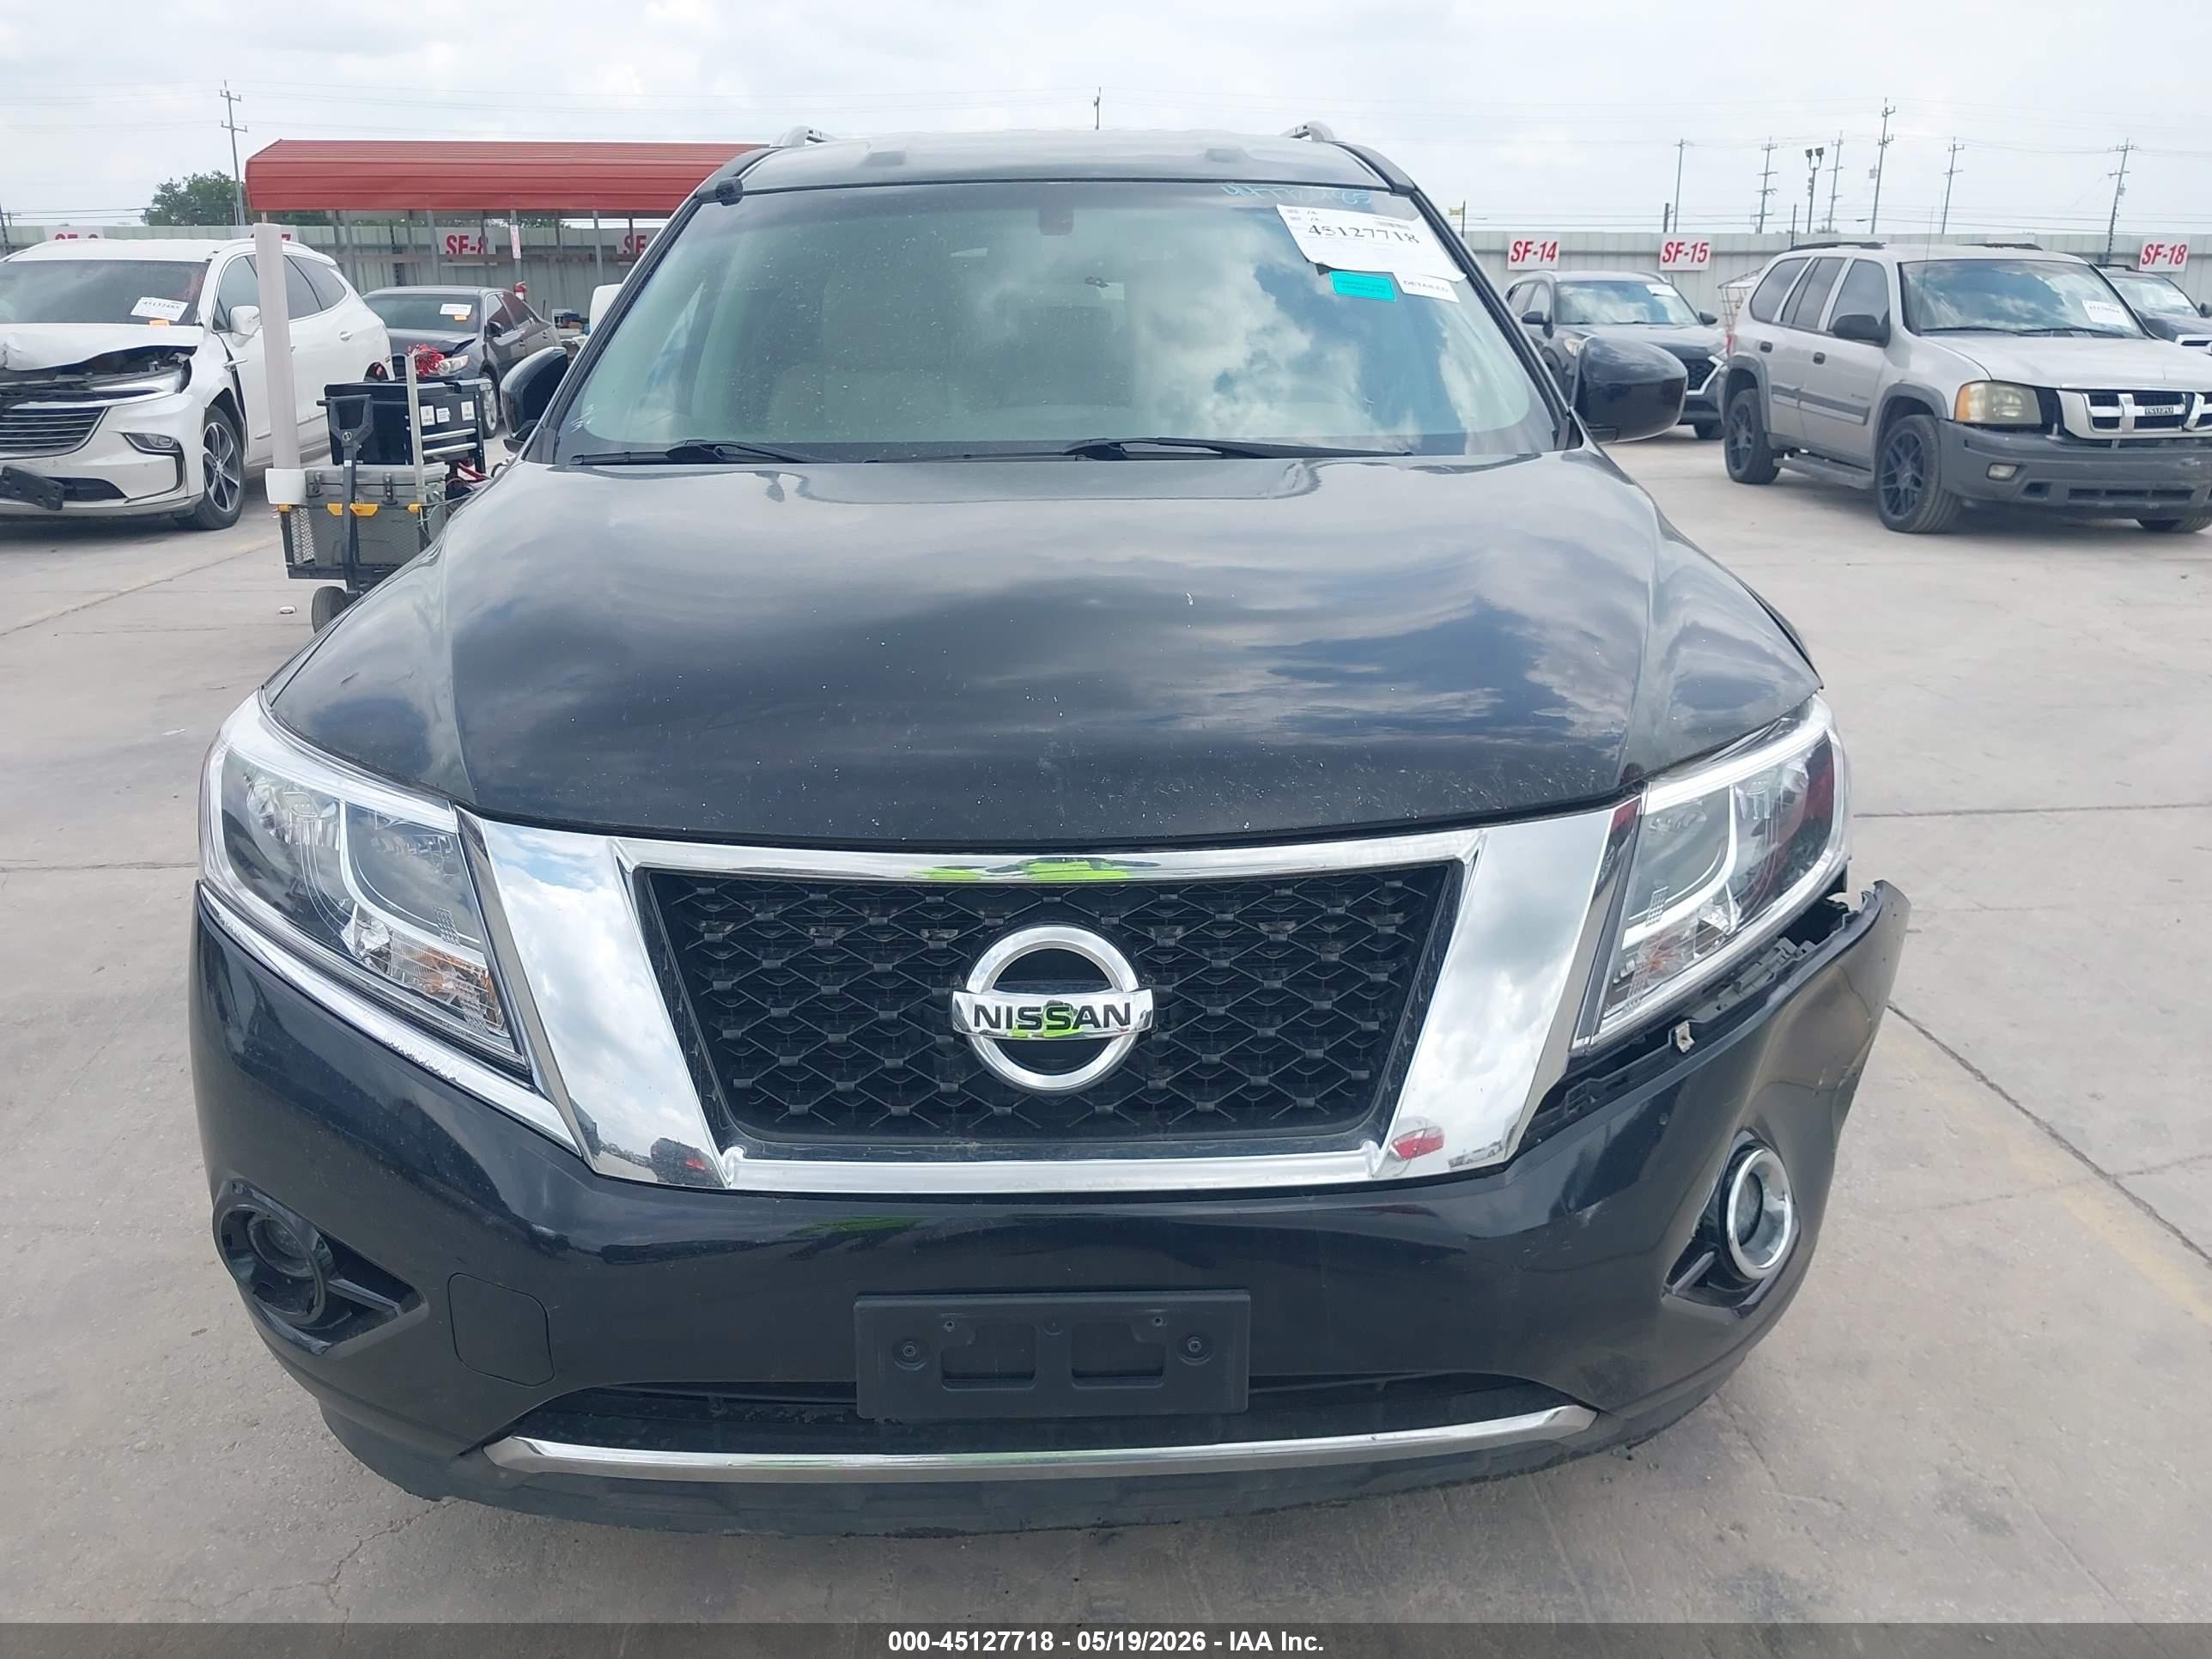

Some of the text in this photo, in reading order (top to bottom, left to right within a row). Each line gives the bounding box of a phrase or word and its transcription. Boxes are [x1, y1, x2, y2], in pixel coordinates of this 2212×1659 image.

[1308, 224, 1420, 244] 45127718
[1510, 240, 1558, 262] SF-14
[1662, 241, 1710, 263] SF-15
[2142, 243, 2187, 265] SF-18
[974, 1002, 1131, 1030] NISSAN
